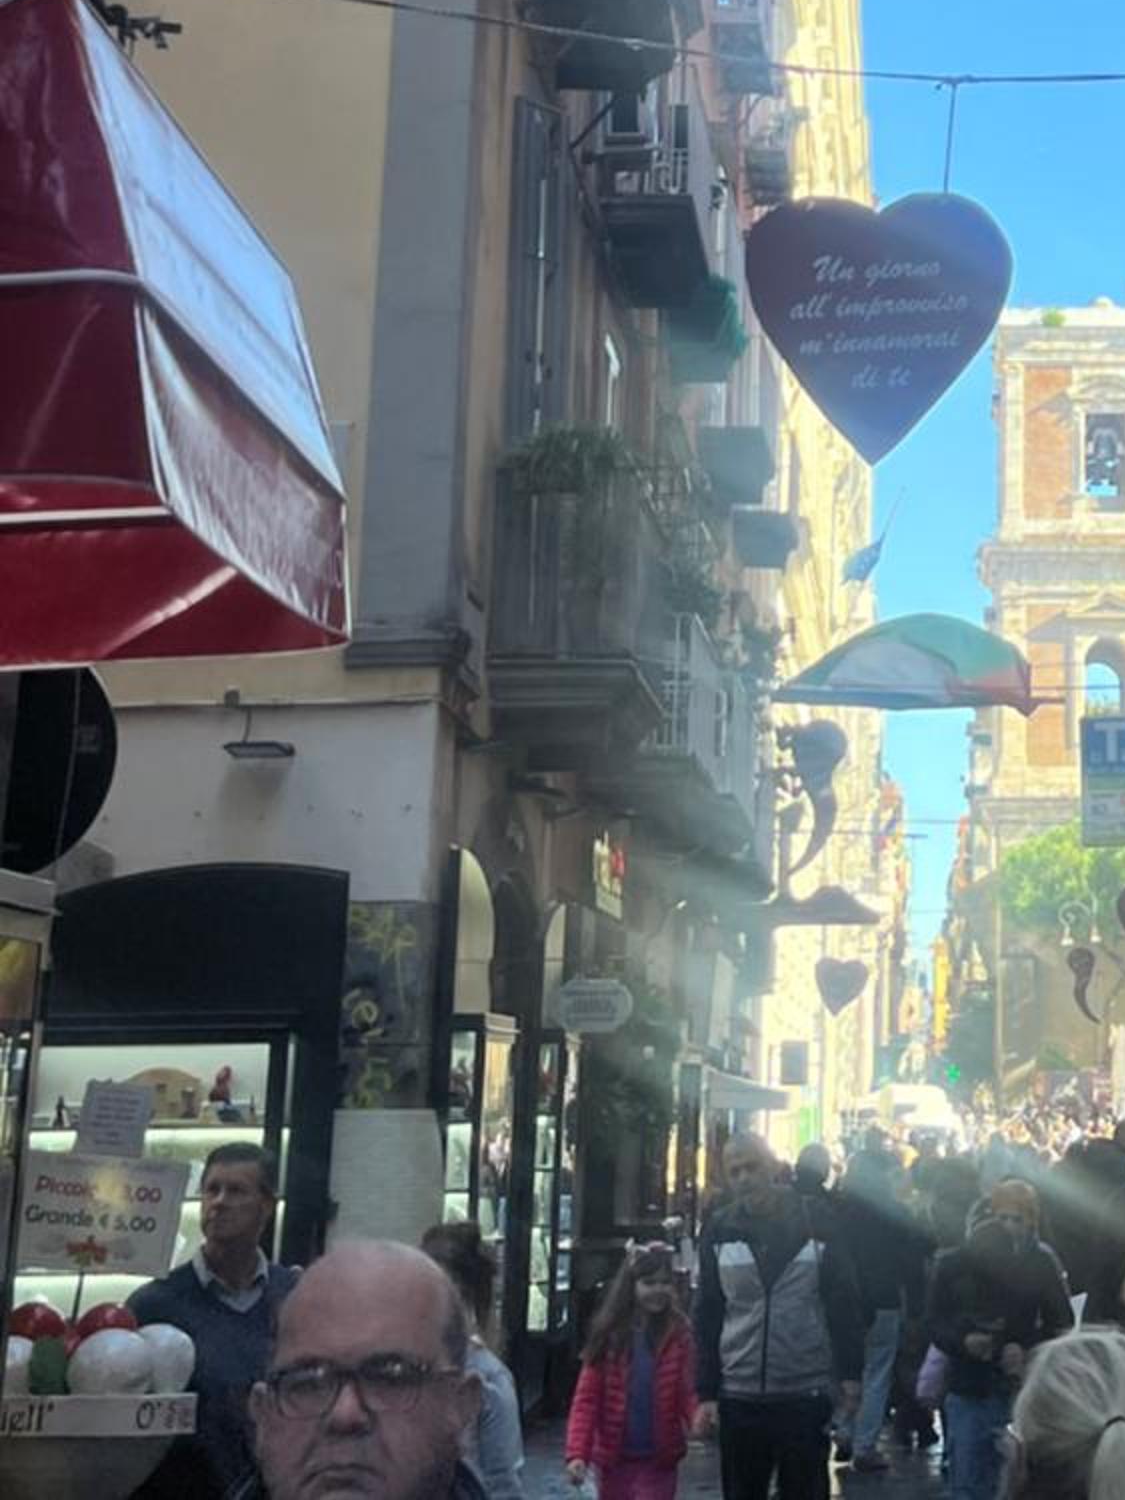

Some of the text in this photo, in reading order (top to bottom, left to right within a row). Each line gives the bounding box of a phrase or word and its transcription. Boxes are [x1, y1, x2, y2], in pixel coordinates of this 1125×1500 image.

[813, 255, 942, 288] Un giorno
[25, 1204, 94, 1227] Grande
